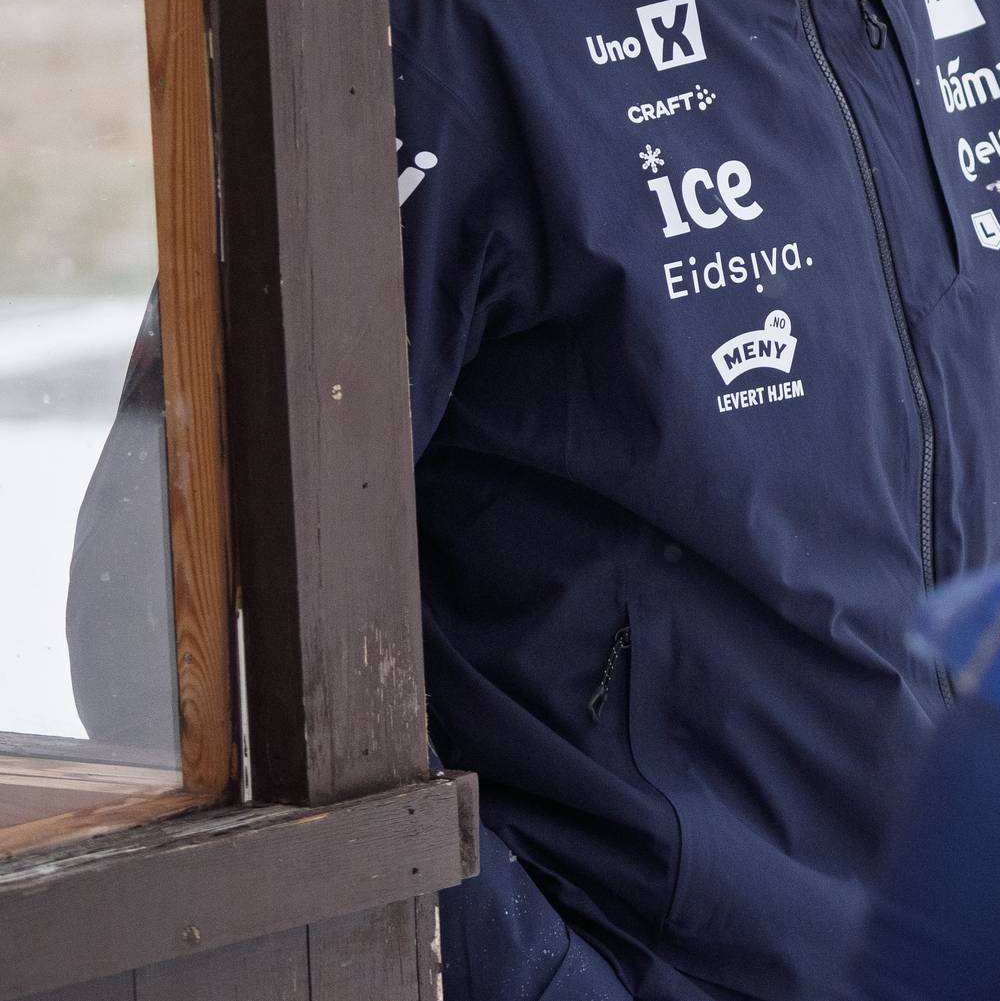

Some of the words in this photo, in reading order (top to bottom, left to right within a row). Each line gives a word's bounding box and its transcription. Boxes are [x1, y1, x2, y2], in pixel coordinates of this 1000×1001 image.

[585, 34, 642, 65] Uno
[627, 91, 695, 124] CRAFT
[638, 143, 764, 239] ice
[723, 340, 787, 370] MENY
[717, 386, 765, 413] LEVERT
[767, 379, 805, 403] HJEM
